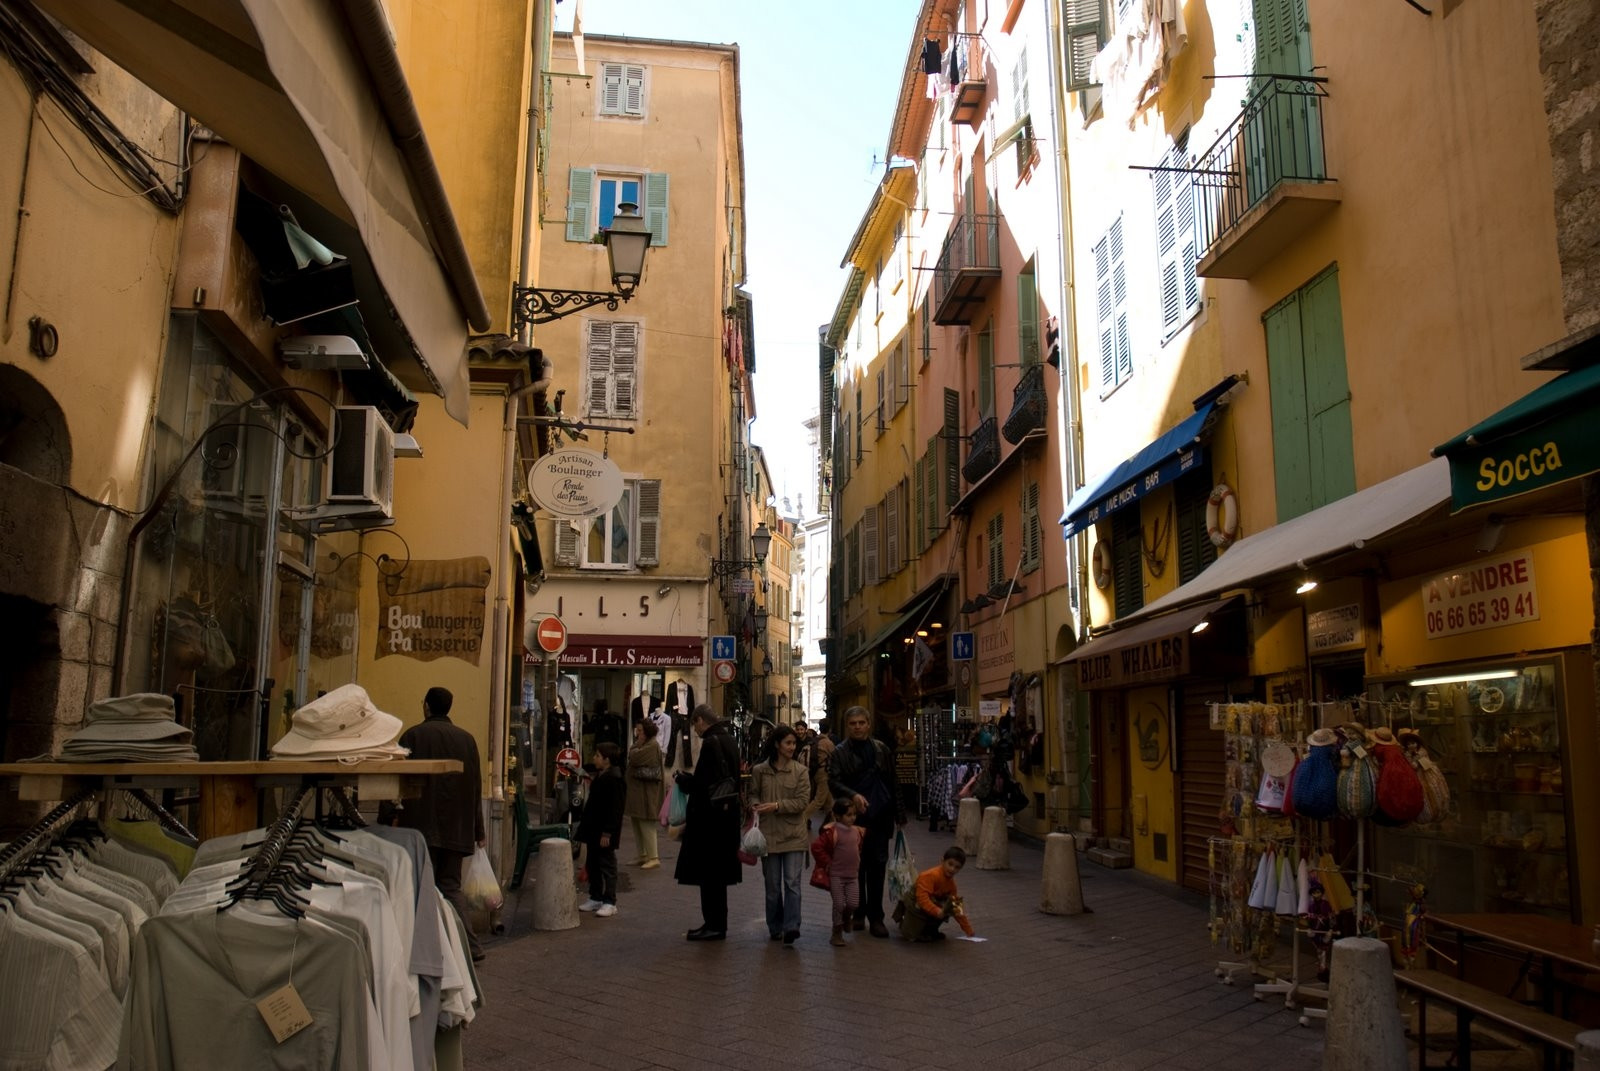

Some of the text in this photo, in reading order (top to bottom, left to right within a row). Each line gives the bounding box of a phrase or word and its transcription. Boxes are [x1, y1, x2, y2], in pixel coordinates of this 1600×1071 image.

[547, 464, 603, 478] Boulanger
[558, 454, 594, 467] Artisan
[1476, 441, 1562, 491] Socca
[1088, 470, 1159, 523] PUB LIVE MUSIC BAR
[1446, 558, 1529, 598] VENDRE
[387, 605, 482, 636] Boulangerie
[1426, 591, 1534, 634] 06 66 65 39 41
[561, 653, 588, 664] Masculin
[656, 655, 676, 666] porter
[675, 655, 701, 665] Masculin
[1080, 636, 1183, 684] BLUE WHALES
